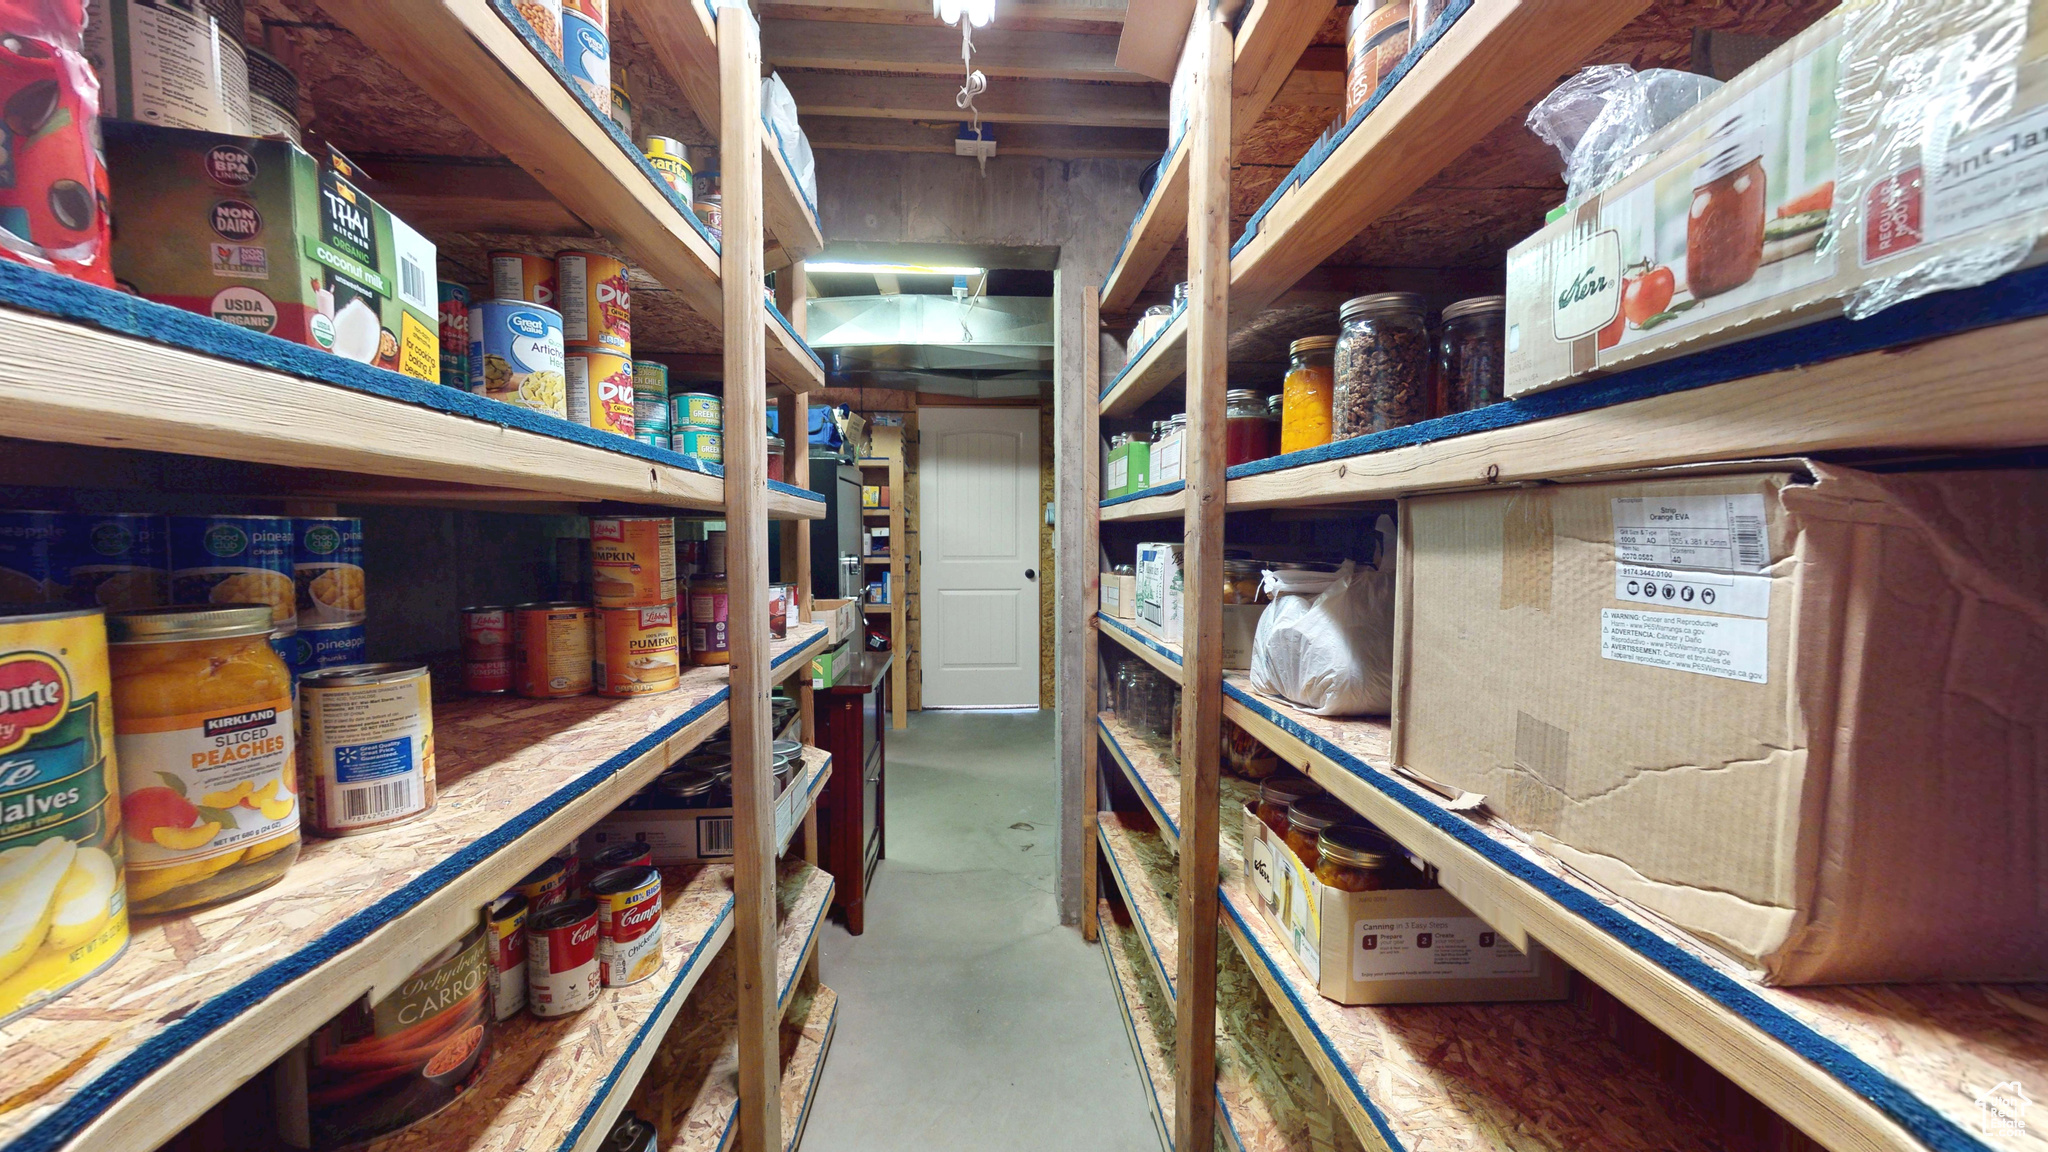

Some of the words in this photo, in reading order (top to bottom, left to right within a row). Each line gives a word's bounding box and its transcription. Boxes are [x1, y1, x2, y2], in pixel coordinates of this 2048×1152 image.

[213, 150, 249, 163] NON
[214, 161, 249, 174] BPA
[215, 171, 249, 181] LINING
[217, 207, 253, 219] NON
[323, 190, 369, 239] THAI
[217, 218, 257, 234] DAIRY
[333, 222, 369, 249] KITCHEN
[333, 236, 369, 263] ORGANIC
[317, 247, 362, 278] coconut
[364, 273, 384, 290] milk
[1558, 266, 1608, 310] Kerr
[224, 298, 264, 312] USDA
[513, 316, 543, 330] Great
[520, 325, 543, 335] Value
[693, 409, 714, 418] GREEN
[1661, 507, 1677, 515] Strip
[1650, 514, 1674, 522] Orange
[212, 533, 239, 541] food
[311, 533, 333, 541] food
[1623, 568, 1673, 578] 9174.3442.0100
[1611, 612, 1640, 621] WARNING:
[1642, 615, 1662, 623] Cancer
[1676, 618, 1719, 627] Reproductive
[1611, 628, 1655, 639] ADVERTENCIA:
[629, 636, 678, 649] PUMPKIN
[1611, 636, 1646, 645] Reproductivo
[1611, 643, 1662, 656] AVERTISSEMENT:
[1663, 650, 1686, 659] Cancer
[1694, 654, 1721, 664] troubles
[1635, 655, 1671, 666] reproducteur
[208, 709, 275, 730] KIRKLAND
[215, 728, 269, 748] SLICED
[191, 736, 285, 769] PEACHES
[360, 744, 378, 752] Great
[360, 751, 399, 761] Guaranteed.
[213, 838, 229, 847] NET
[230, 834, 240, 842] WT
[624, 893, 644, 904] 40%
[1363, 923, 1395, 931] Canning
[1411, 922, 1427, 930] Easy
[1429, 922, 1448, 930] Steps
[627, 931, 654, 957] Chicken
[403, 935, 487, 999] Dehydrated
[398, 956, 488, 1024] CARROTS
